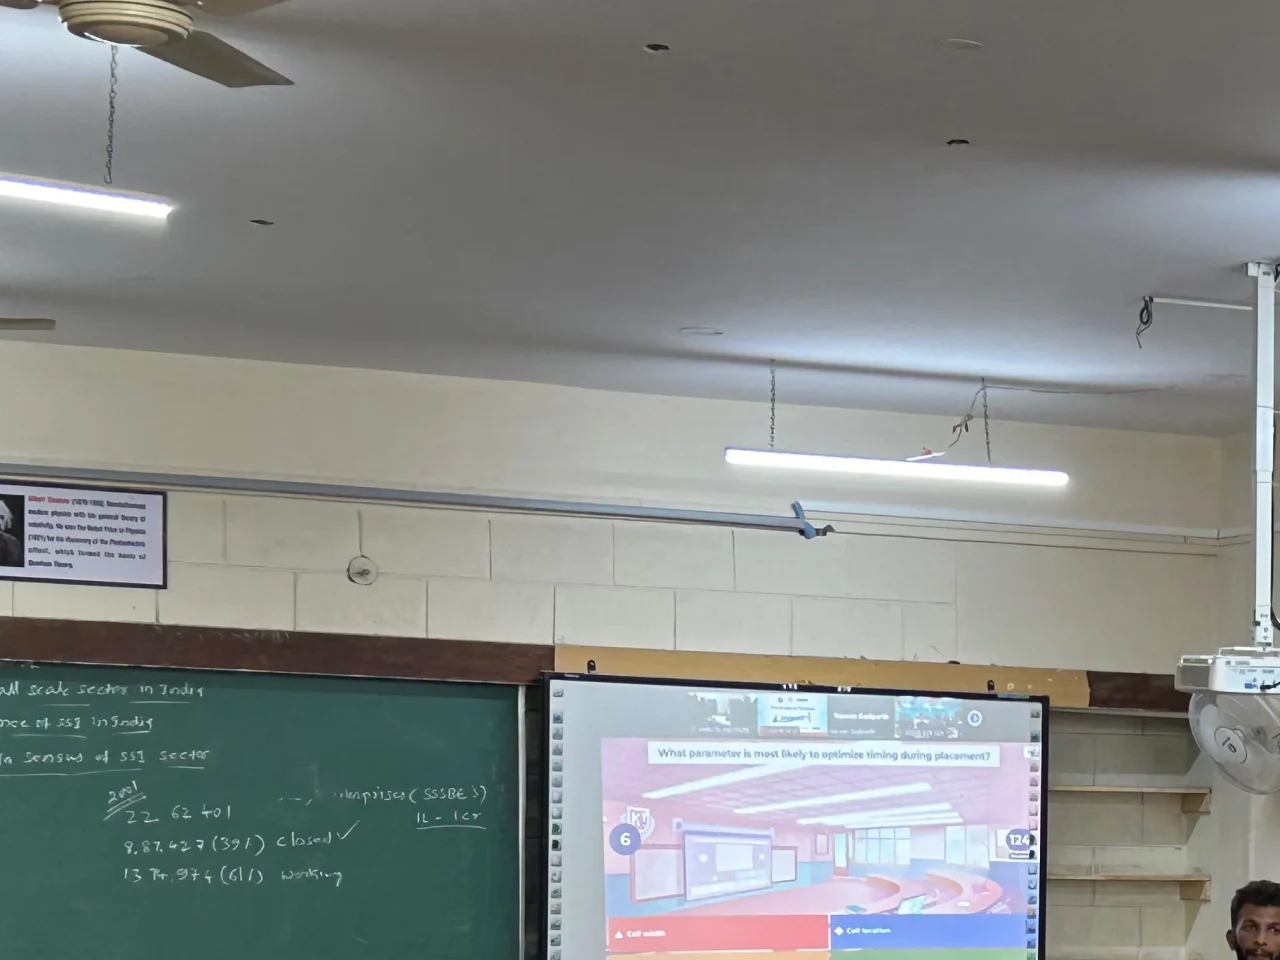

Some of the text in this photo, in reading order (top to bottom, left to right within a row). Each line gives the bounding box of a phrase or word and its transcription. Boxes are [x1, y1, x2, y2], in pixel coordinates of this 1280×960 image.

[658, 747, 991, 763] What parameter is most likely to optimize timing during placement?
[620, 832, 632, 847] 6
